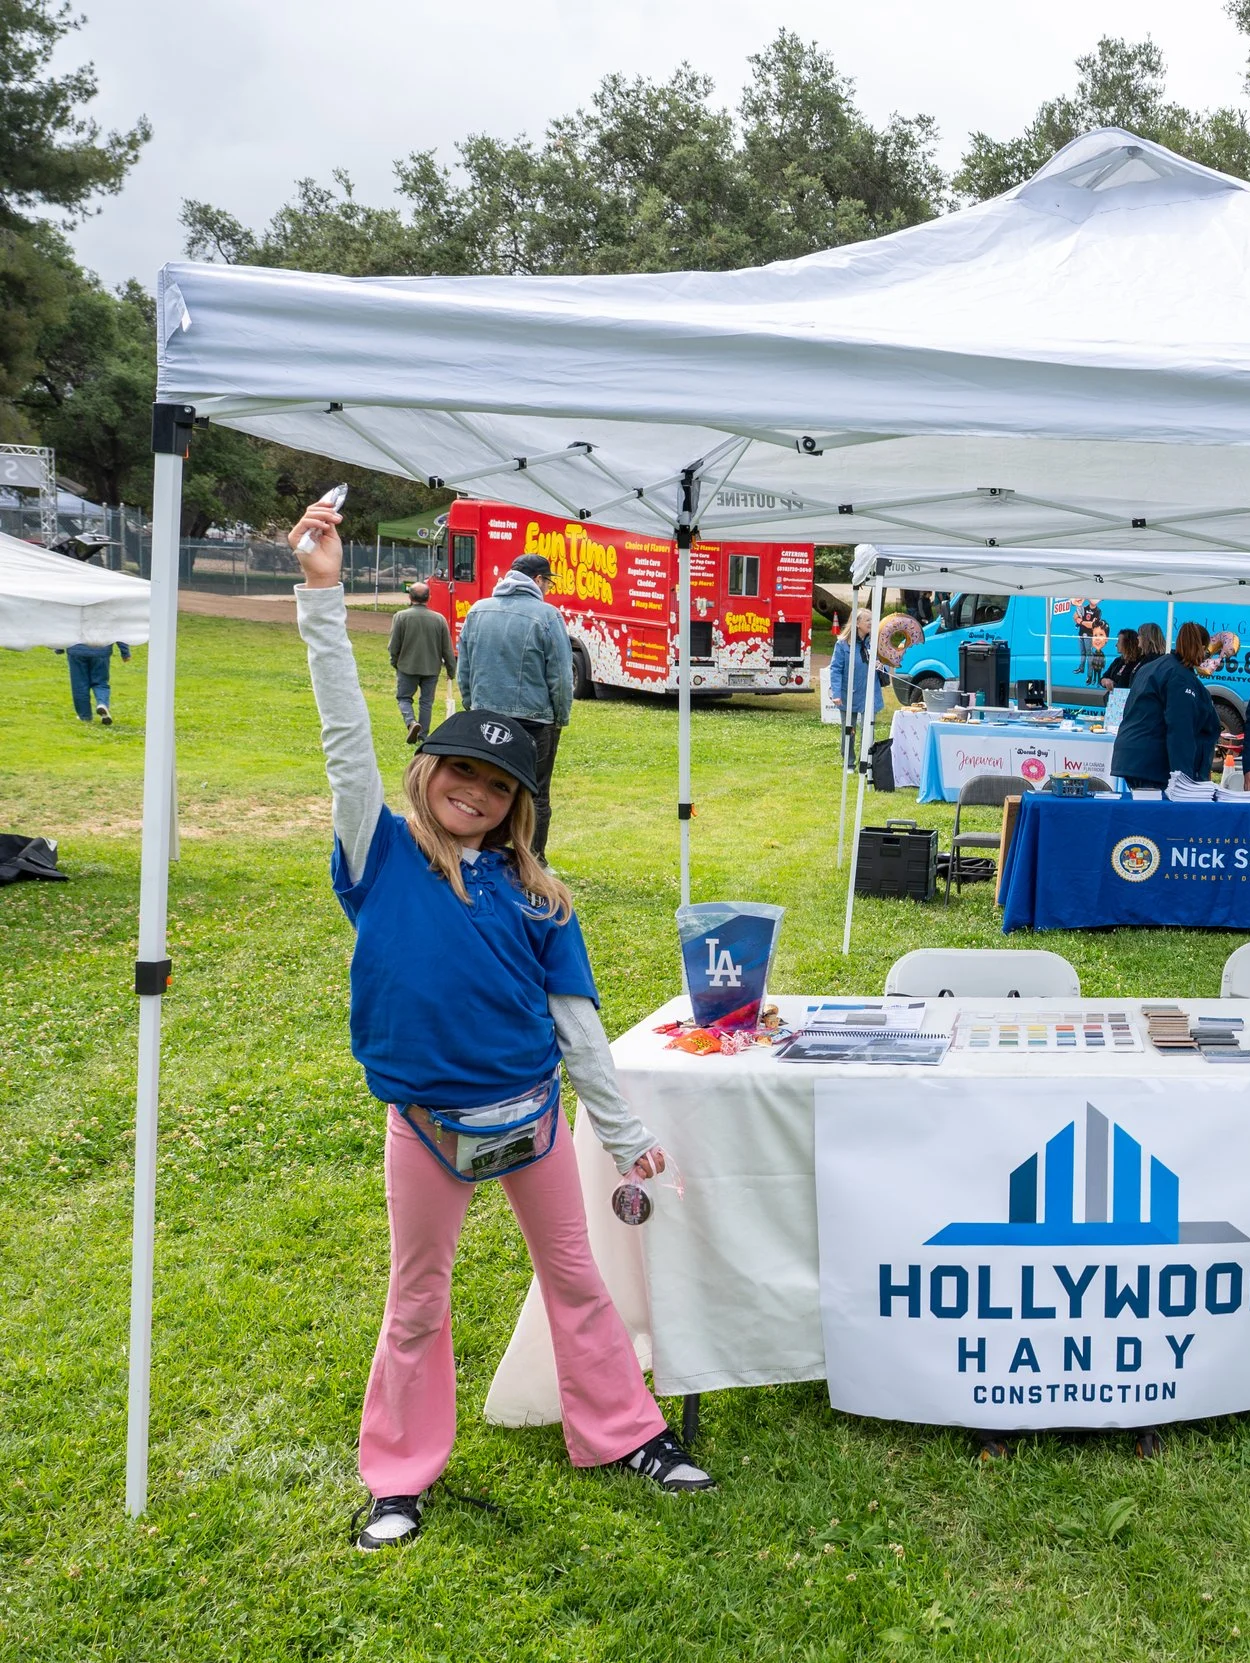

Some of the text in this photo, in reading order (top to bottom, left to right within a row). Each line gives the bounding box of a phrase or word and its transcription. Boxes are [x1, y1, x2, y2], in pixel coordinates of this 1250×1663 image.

[525, 522, 618, 579] Fun Time
[576, 562, 613, 605] Corn
[1054, 601, 1070, 613] SOLD
[725, 612, 770, 627] Fun Time
[1064, 757, 1082, 770] kw
[1171, 847, 1225, 868] Nick
[1164, 873, 1233, 881] ASSEMBLY
[705, 938, 742, 987] LA
[957, 1334, 1196, 1374] HANDY
[973, 1382, 1177, 1405] CONSTRUCTION
